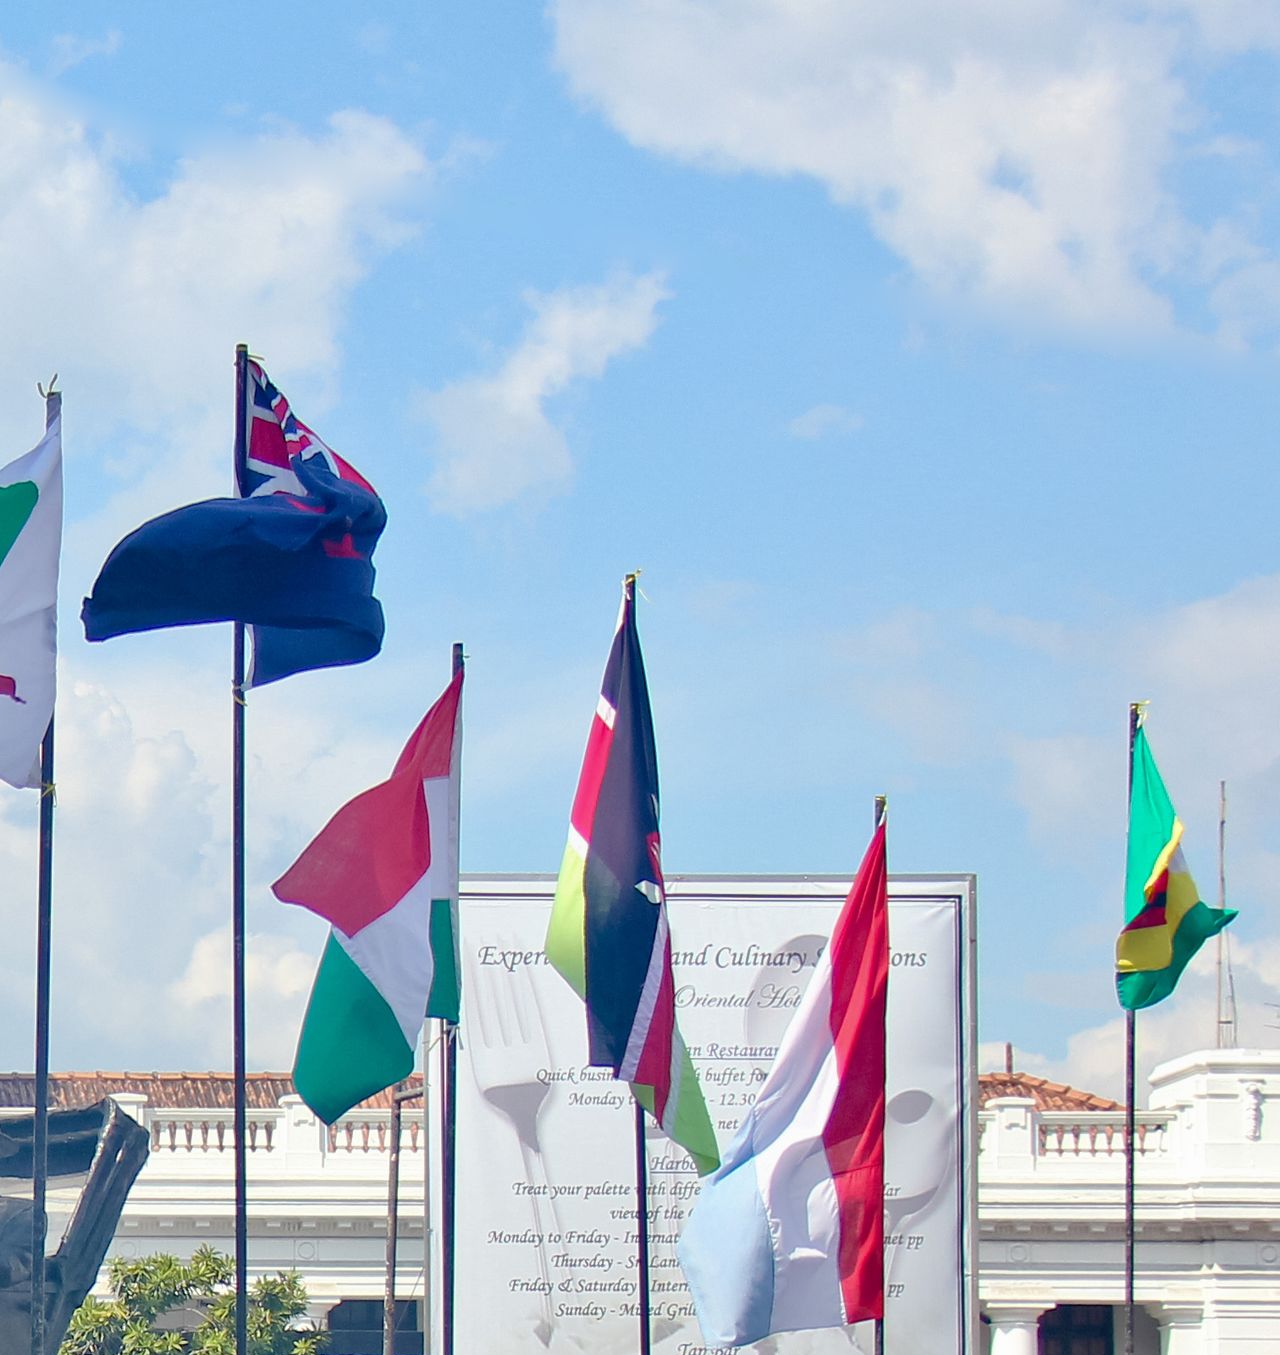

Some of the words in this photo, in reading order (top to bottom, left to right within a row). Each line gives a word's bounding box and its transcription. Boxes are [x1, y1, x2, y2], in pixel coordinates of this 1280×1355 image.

[715, 943, 807, 973] Culinary
[674, 984, 756, 1009] Oriental
[536, 1066, 575, 1083] Quick
[705, 1067, 745, 1085] buffet
[568, 1092, 625, 1111] Monday
[717, 1120, 739, 1130] net
[651, 1157, 697, 1171] Harbo
[512, 1181, 548, 1197] Treat
[550, 1184, 582, 1200] your
[584, 1181, 631, 1200] palette
[646, 1206, 661, 1224] of
[664, 1206, 684, 1220] the
[487, 1229, 544, 1247] Monday
[547, 1231, 561, 1244] to
[565, 1229, 611, 1247] Friday
[906, 1234, 924, 1250] pp
[551, 1253, 614, 1272] Thursday
[509, 1278, 553, 1296] Friday
[574, 1278, 637, 1296] Saturday
[555, 1302, 607, 1322] Sunday
[619, 1303, 662, 1318] Mied
